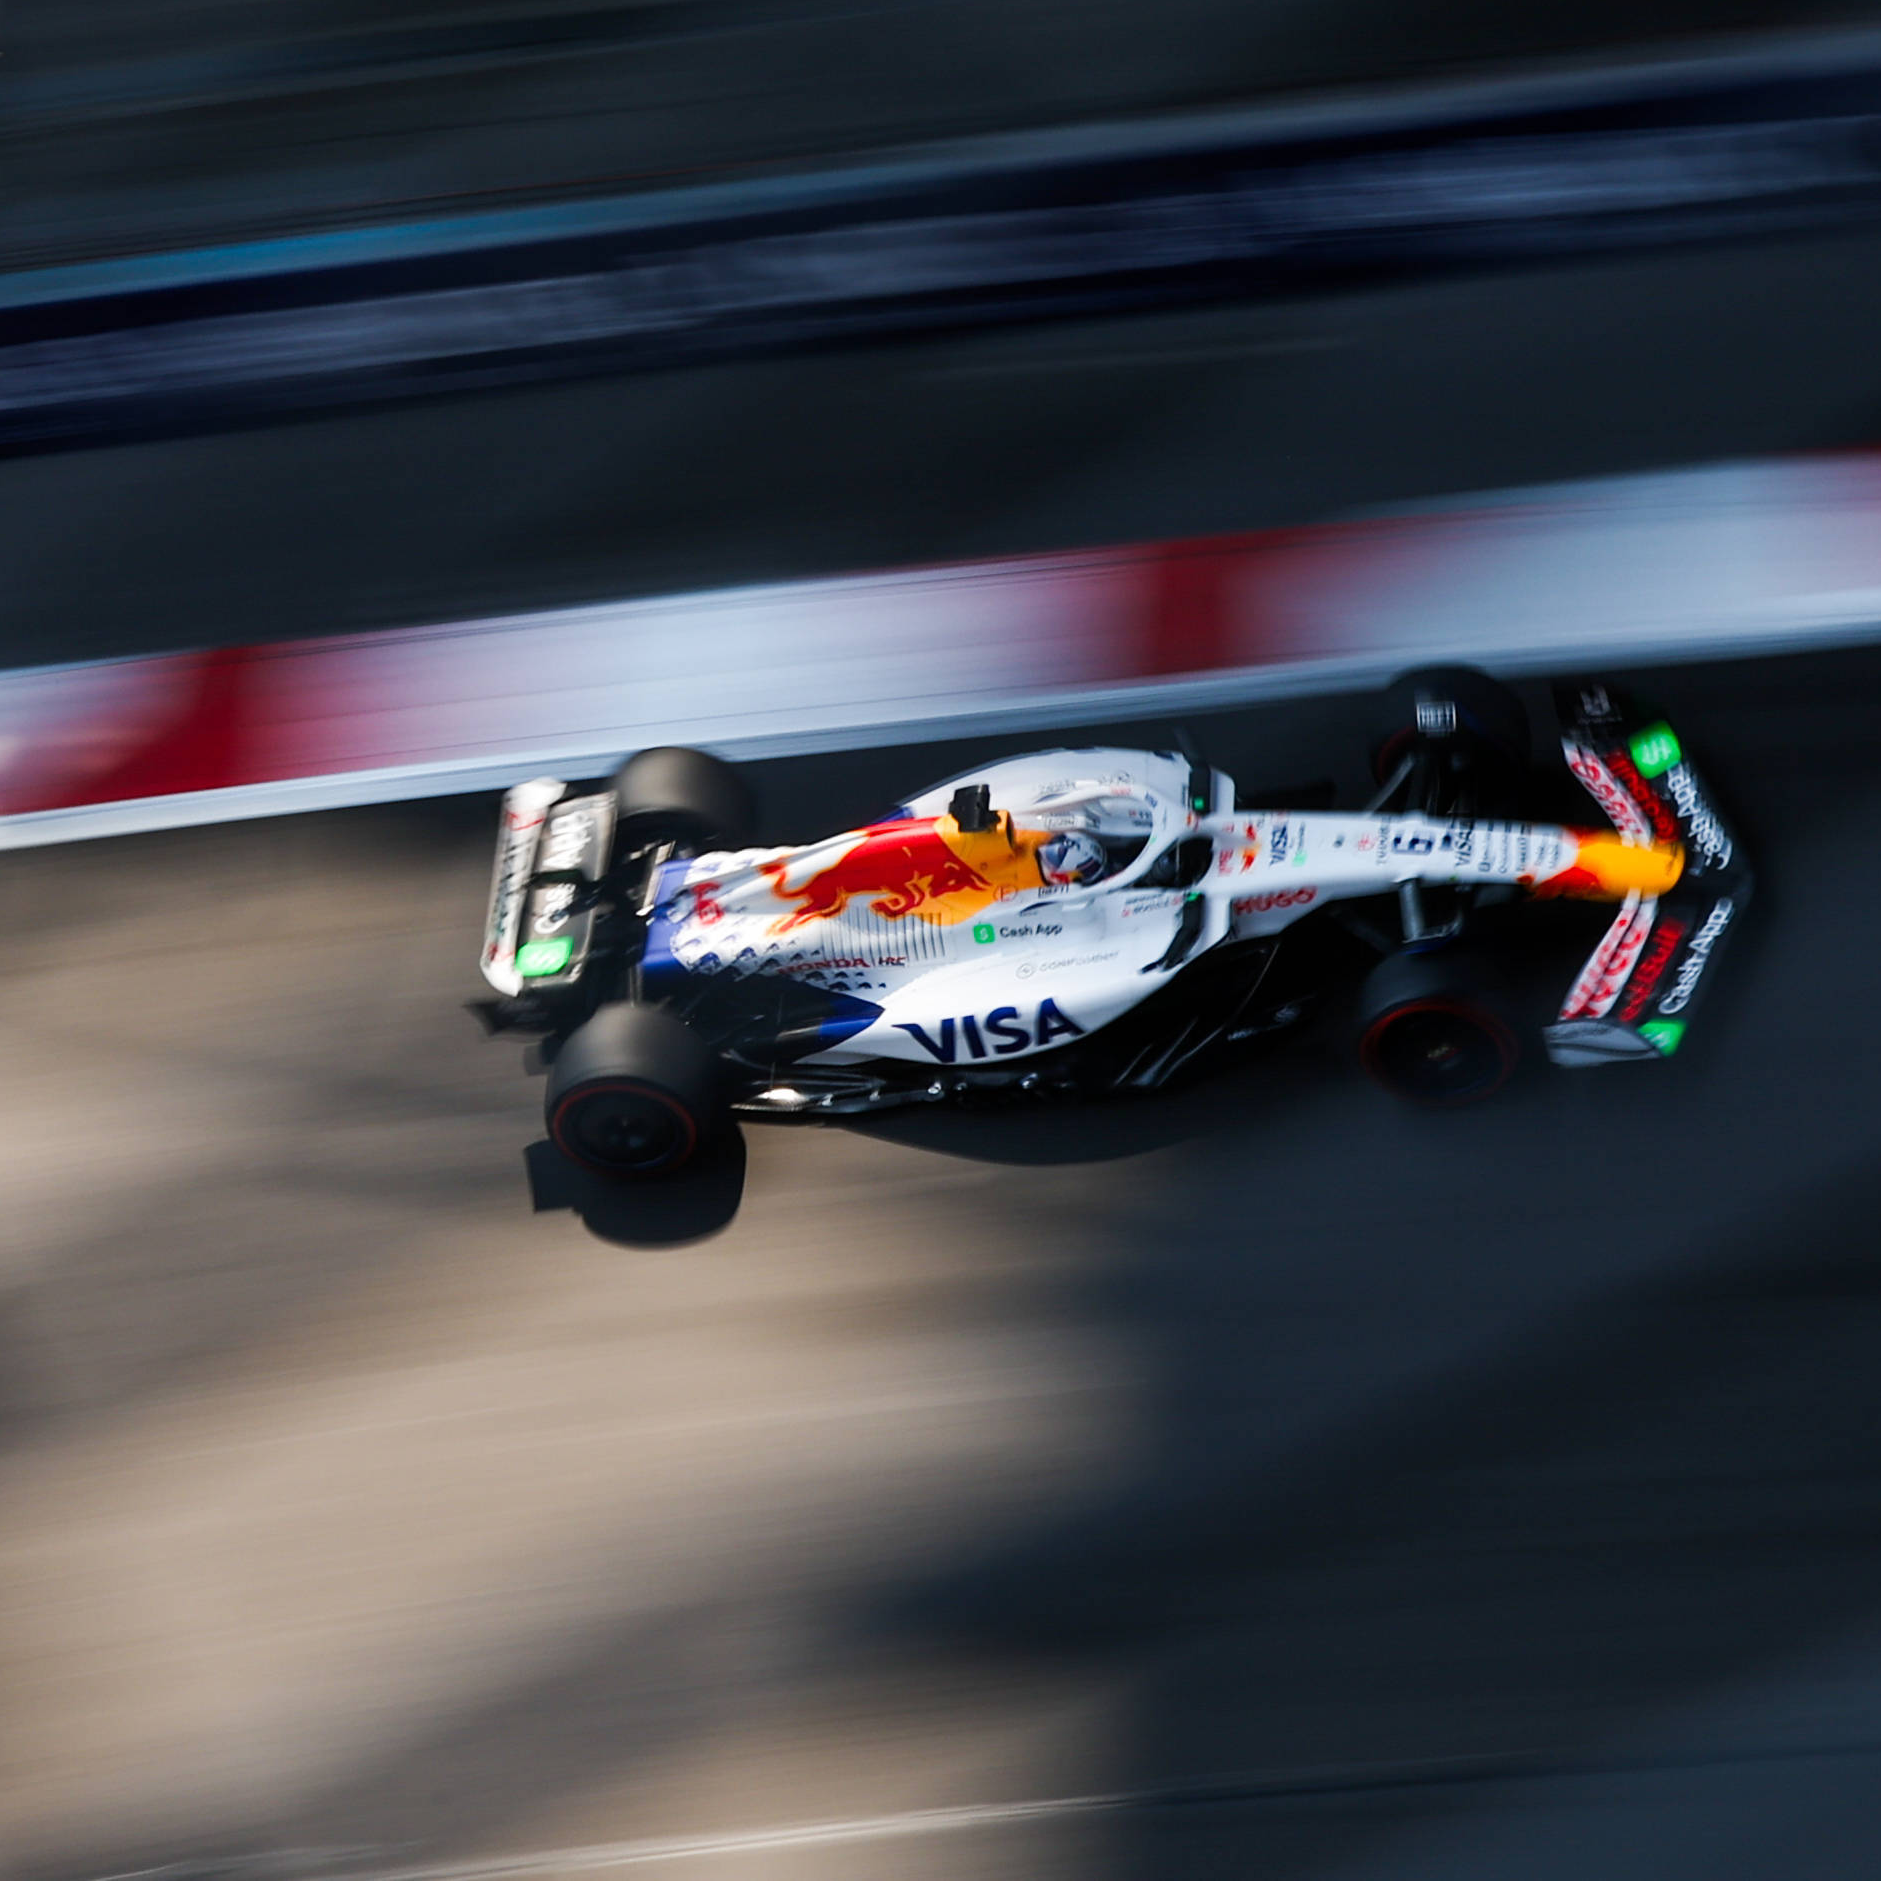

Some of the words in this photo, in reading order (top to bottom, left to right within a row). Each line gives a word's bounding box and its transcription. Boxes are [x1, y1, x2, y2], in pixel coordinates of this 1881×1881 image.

[1232, 885, 1318, 915] HUGO
[999, 924, 1034, 938] Cash
[1035, 923, 1063, 937] App
[890, 996, 1087, 1064] VISA
